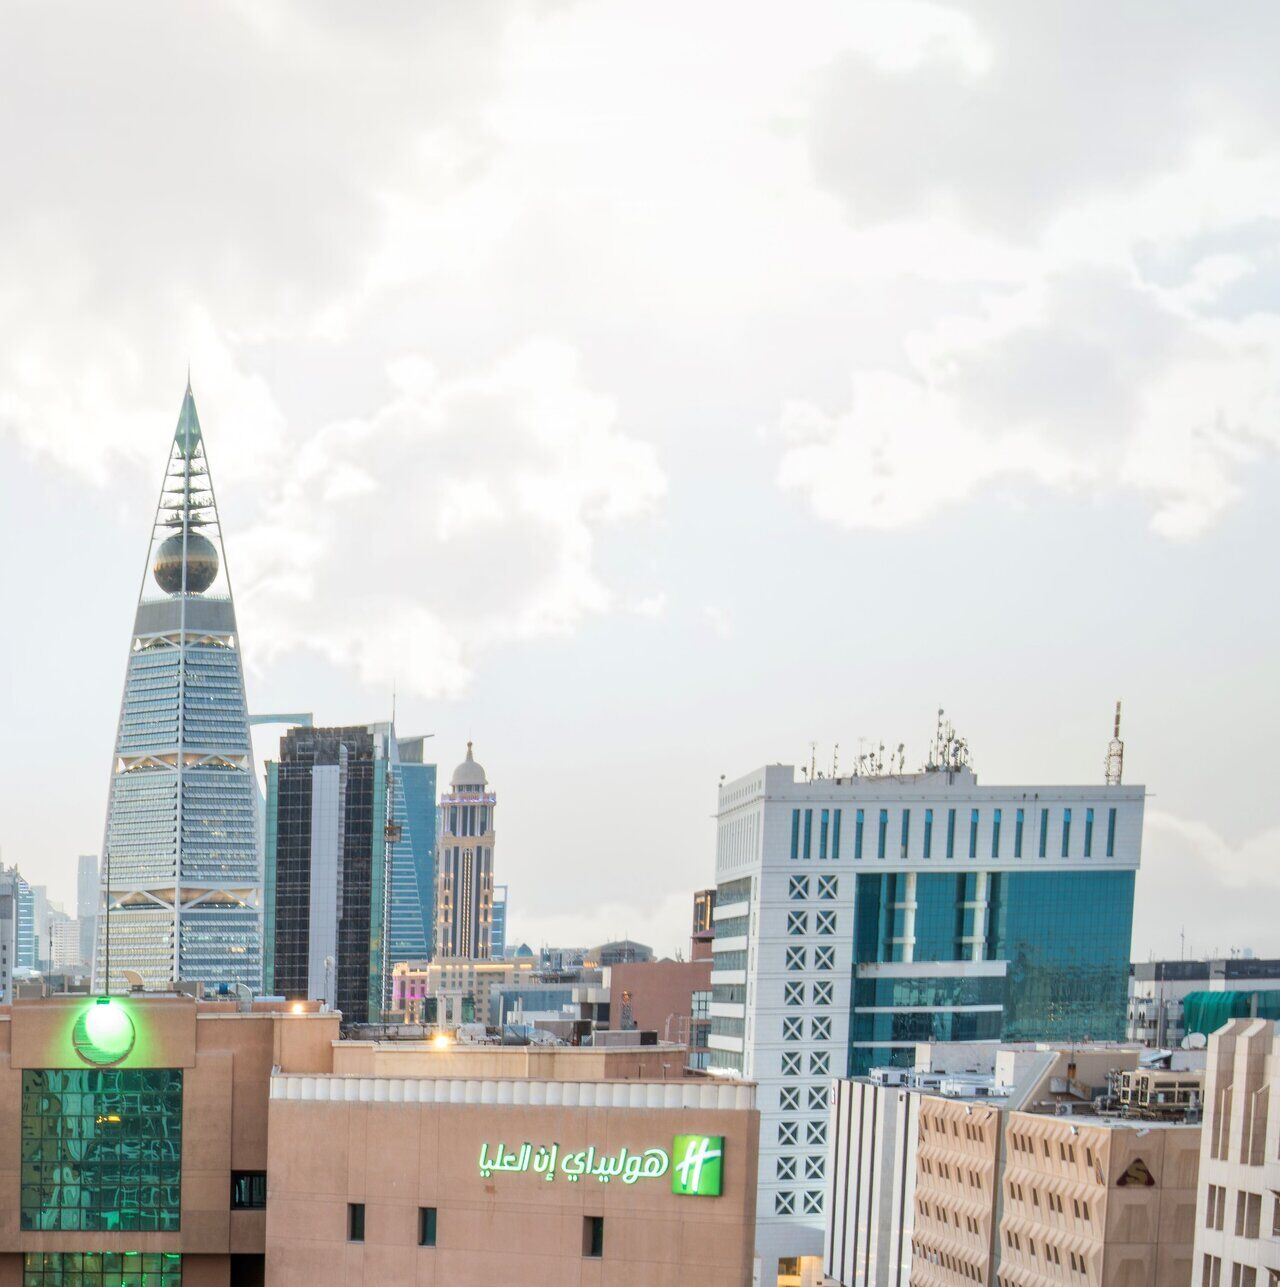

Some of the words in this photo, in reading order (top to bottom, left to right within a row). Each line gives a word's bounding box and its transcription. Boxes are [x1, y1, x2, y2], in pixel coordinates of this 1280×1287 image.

[479, 1143, 532, 1177] العليا
[533, 1143, 559, 1181] إن
[562, 1146, 669, 1184] هوليداي
